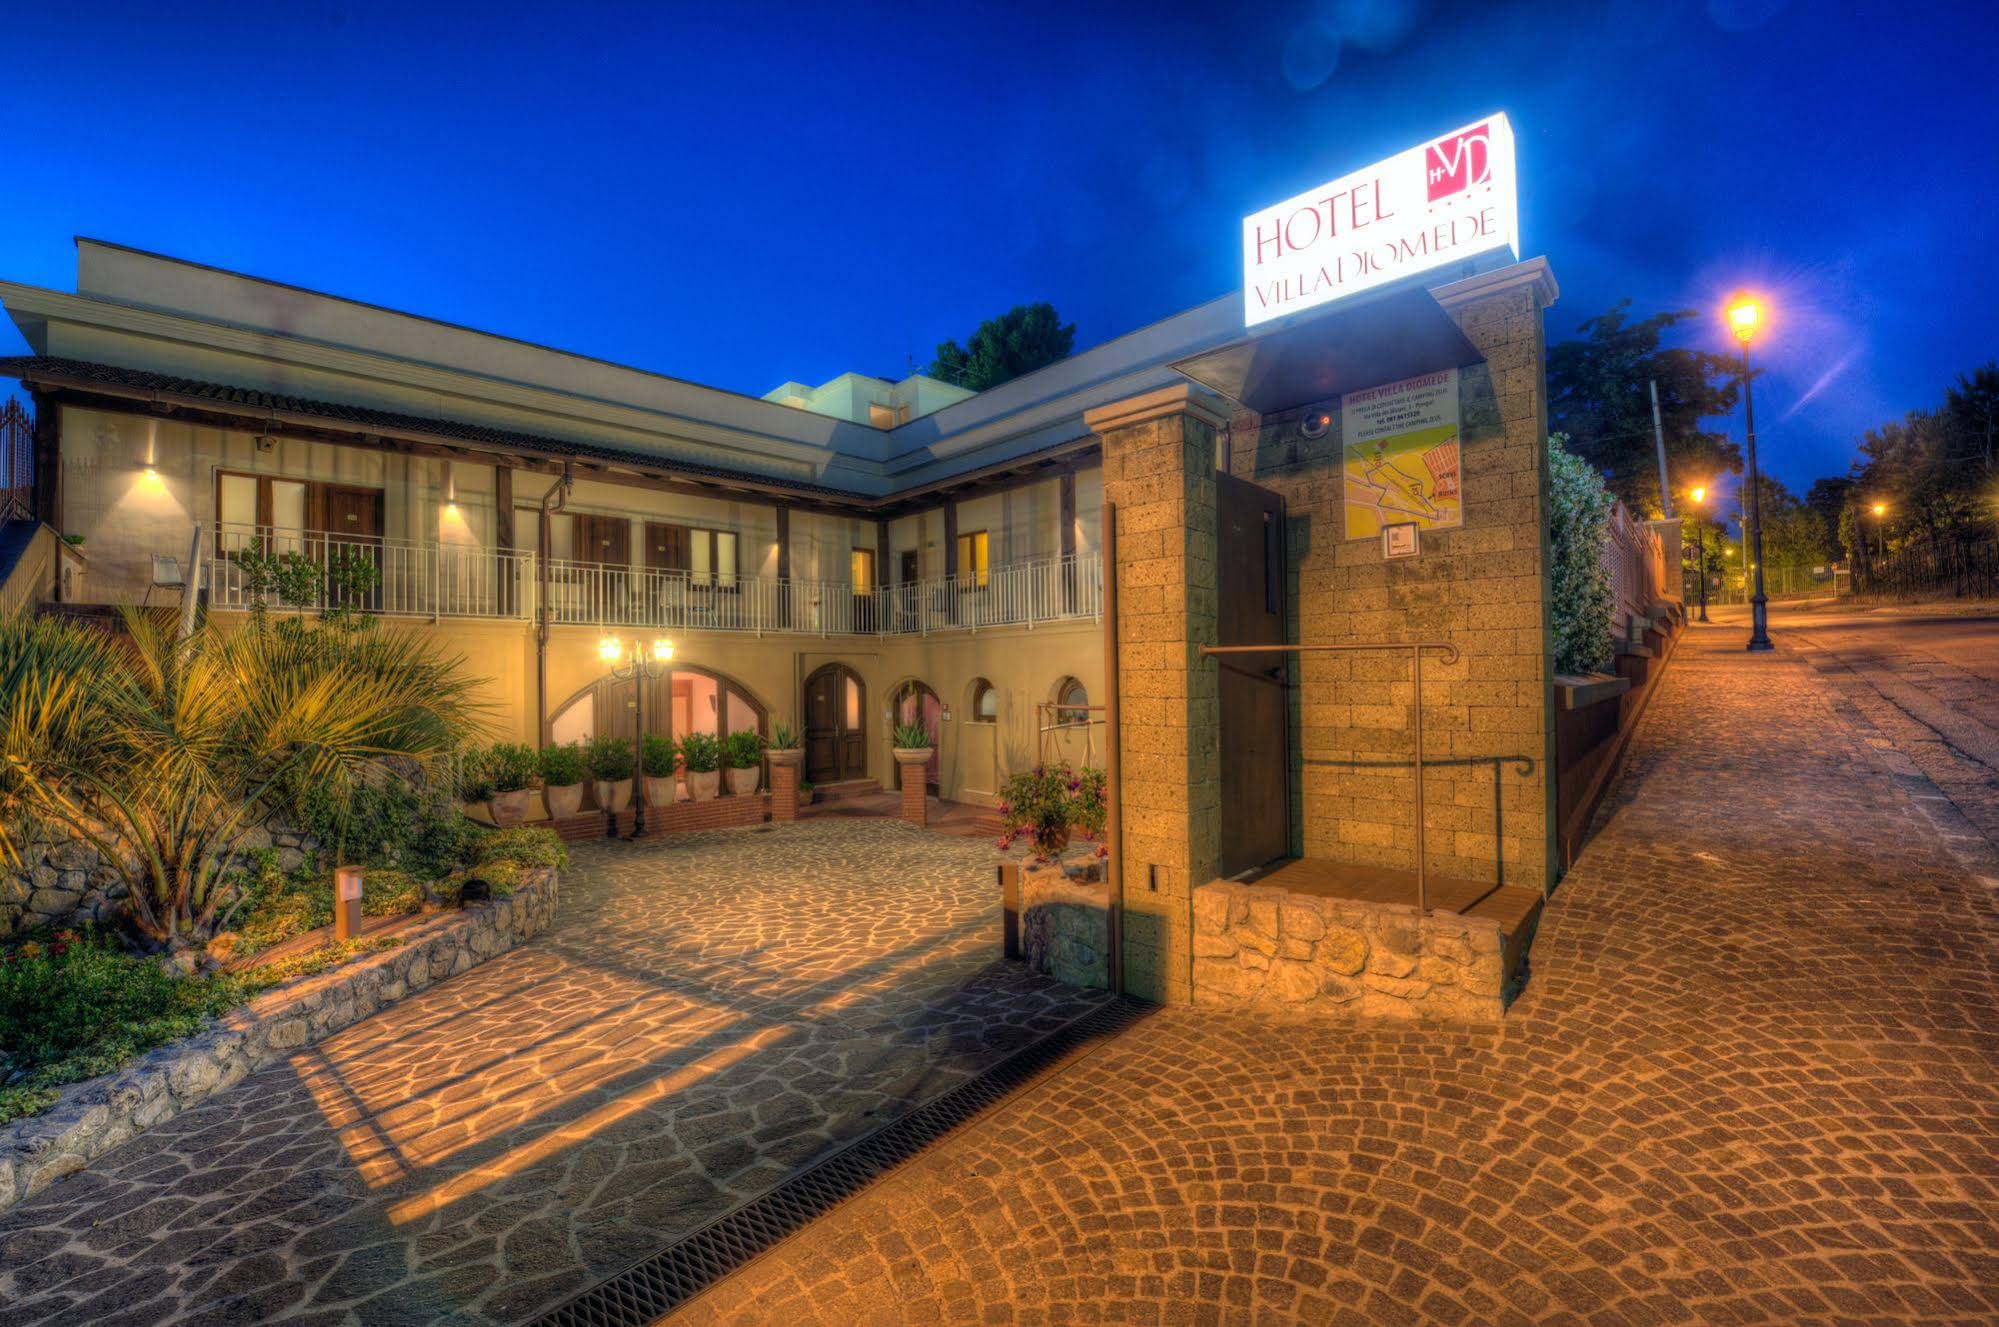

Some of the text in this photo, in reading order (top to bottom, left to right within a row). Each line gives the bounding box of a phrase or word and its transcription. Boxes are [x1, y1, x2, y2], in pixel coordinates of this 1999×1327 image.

[1255, 178, 1395, 265] HOTEL
[1349, 392, 1377, 405] HOTEL
[1377, 384, 1404, 399] VILLA
[1406, 374, 1449, 392] DIOMEDE
